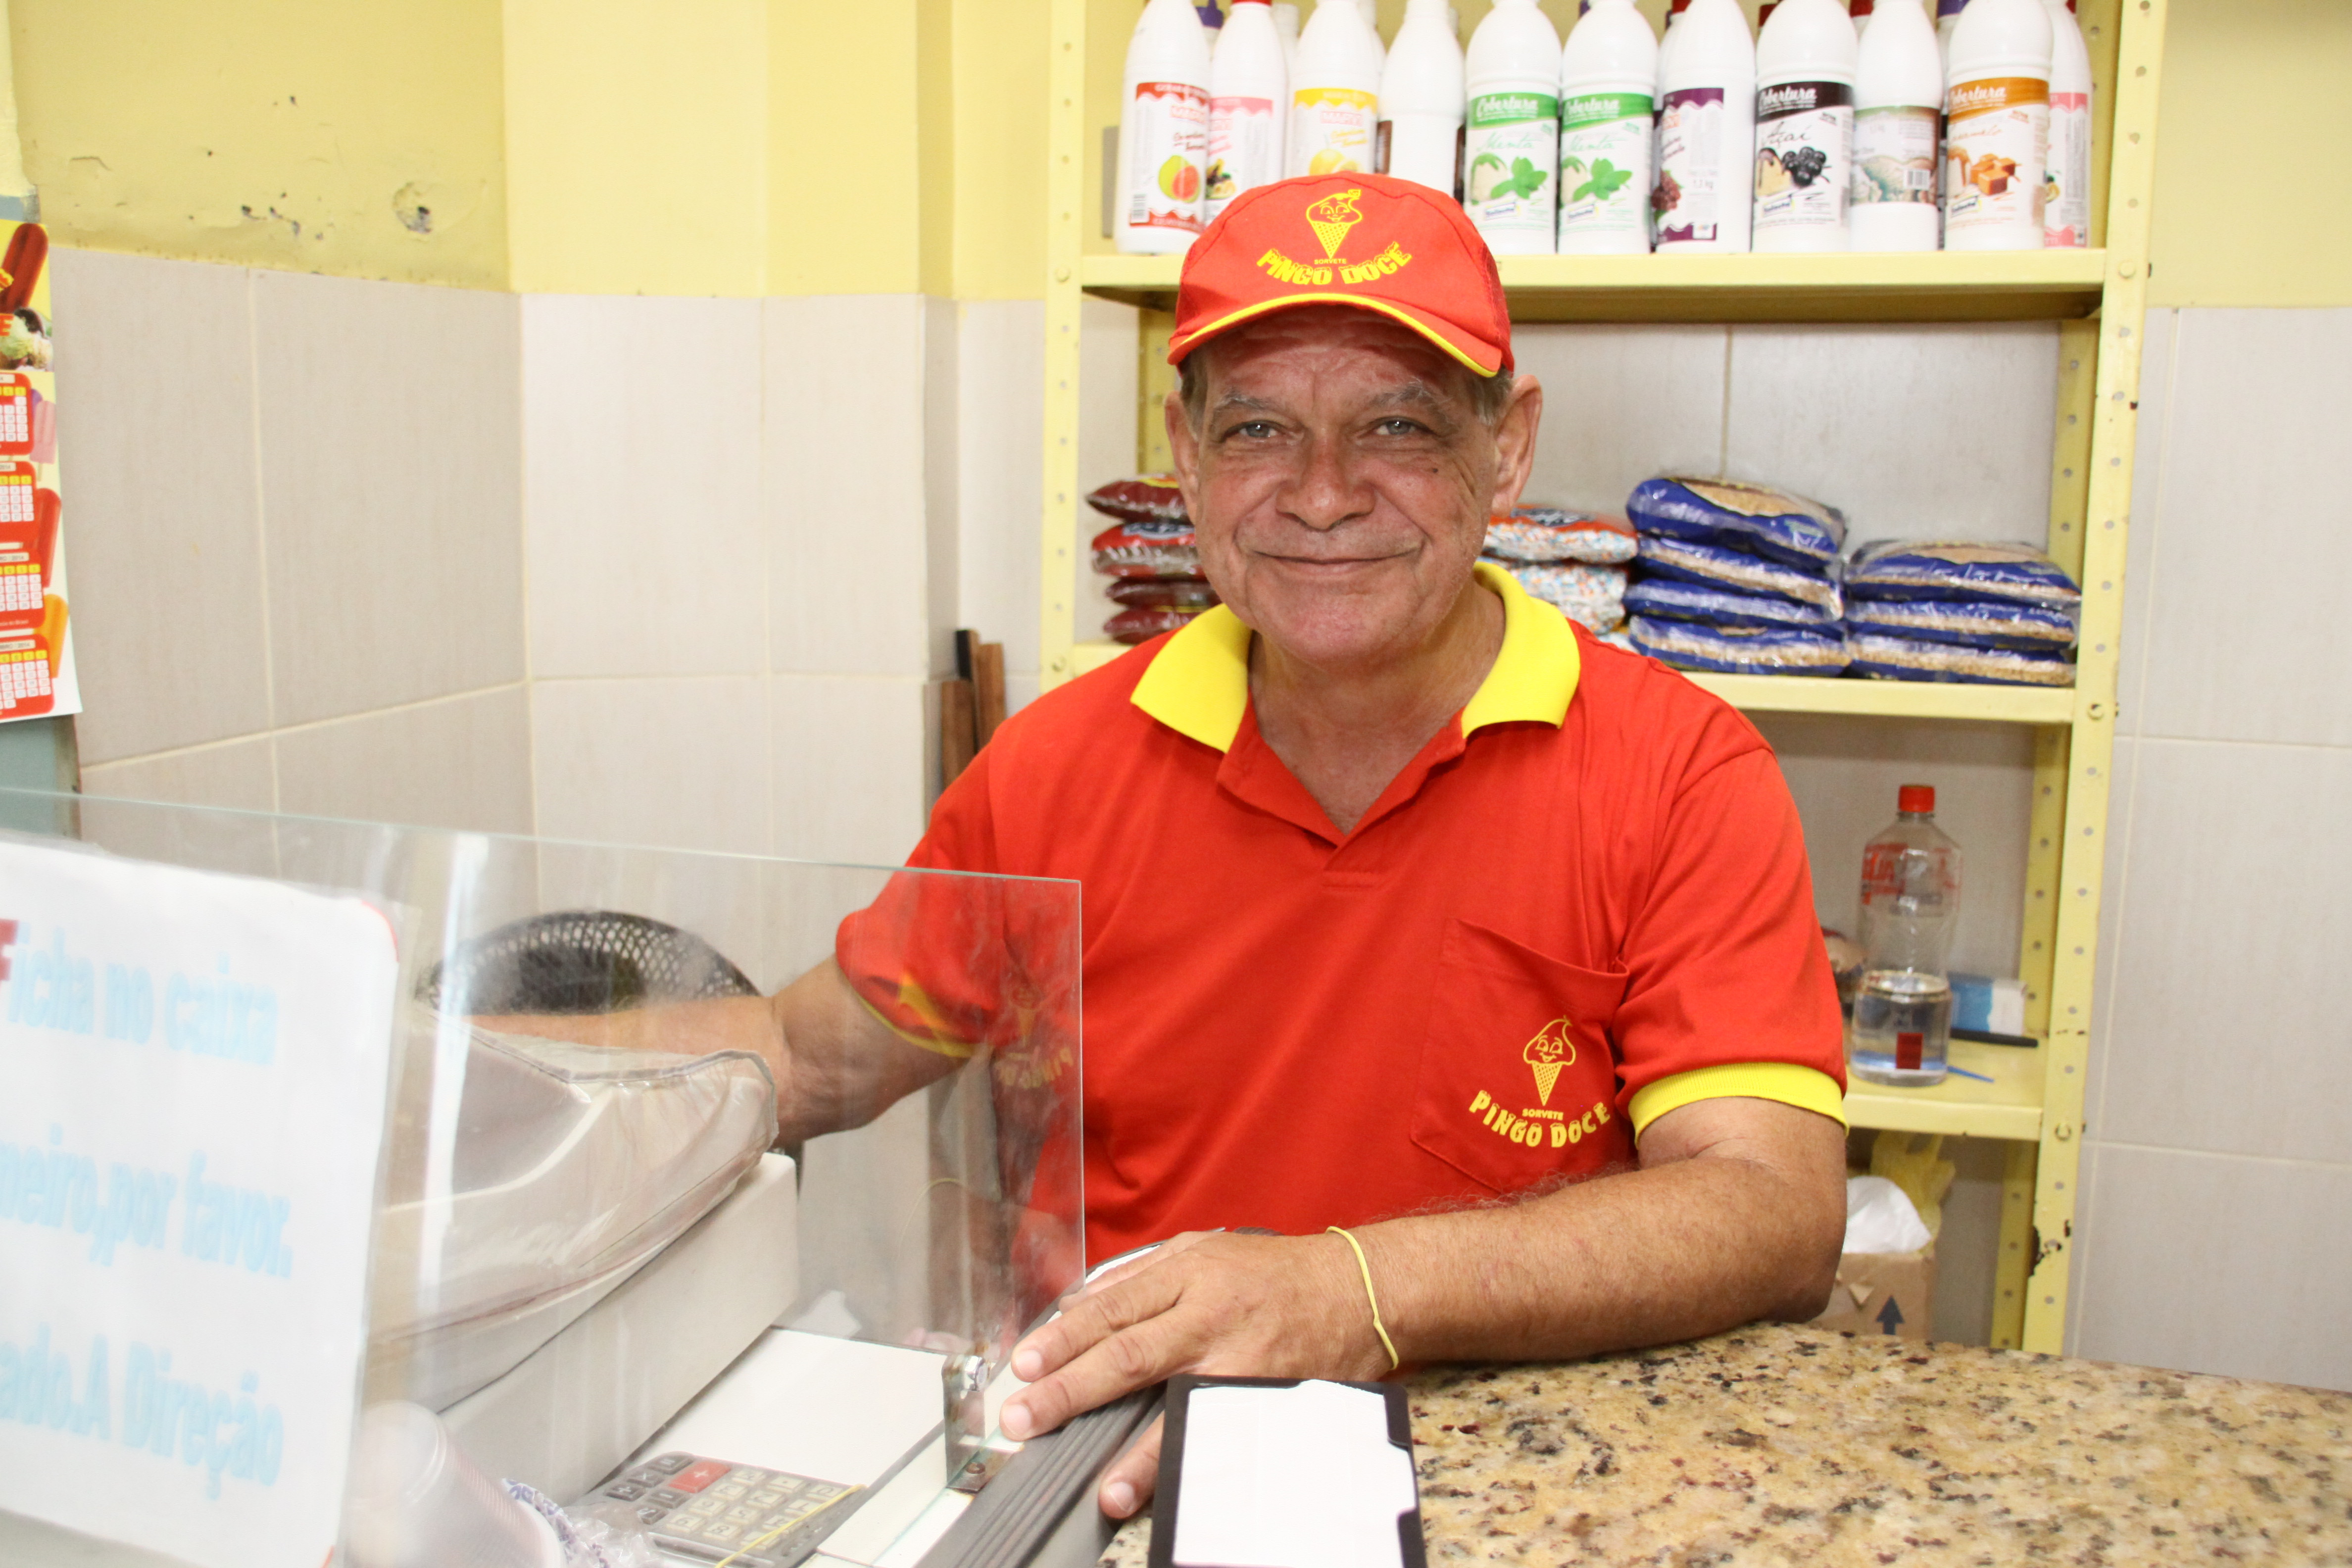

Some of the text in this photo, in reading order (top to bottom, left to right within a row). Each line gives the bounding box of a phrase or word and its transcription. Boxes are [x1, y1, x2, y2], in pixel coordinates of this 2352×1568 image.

[1256, 241, 1412, 285] PINGO DOCE
[104, 962, 151, 1045] no
[165, 950, 279, 1066] caixa
[1469, 1090, 1610, 1148] PINGO DOCE
[1522, 1108, 1564, 1121] SORVETE
[182, 1148, 294, 1279] favor.
[122, 1340, 284, 1500] Direção
